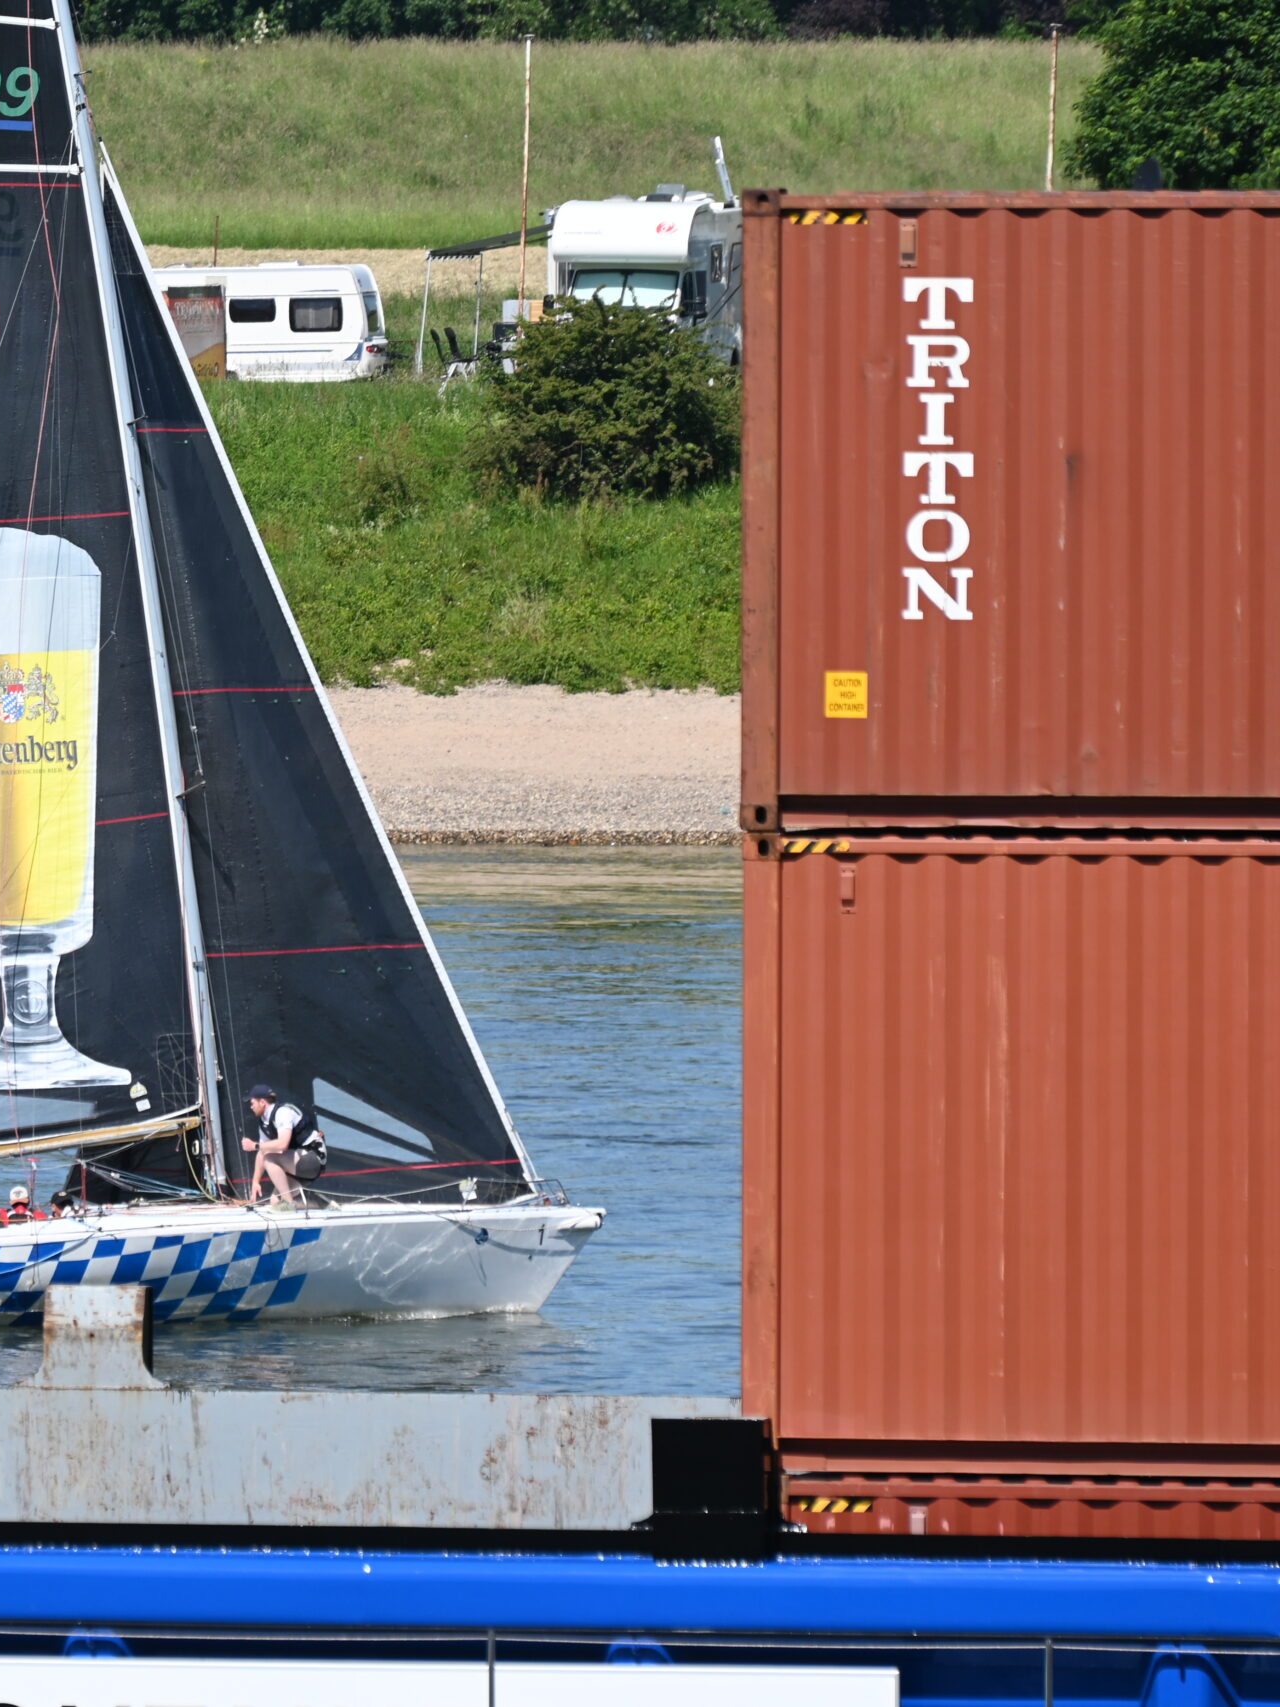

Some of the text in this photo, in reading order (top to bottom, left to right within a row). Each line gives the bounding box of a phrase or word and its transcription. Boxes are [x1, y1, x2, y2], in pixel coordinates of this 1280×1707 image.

[901, 277, 974, 620] TRITON
[833, 679, 863, 687] CAUTION
[840, 691, 857, 699] HIGH
[829, 703, 865, 712] CONTAINER
